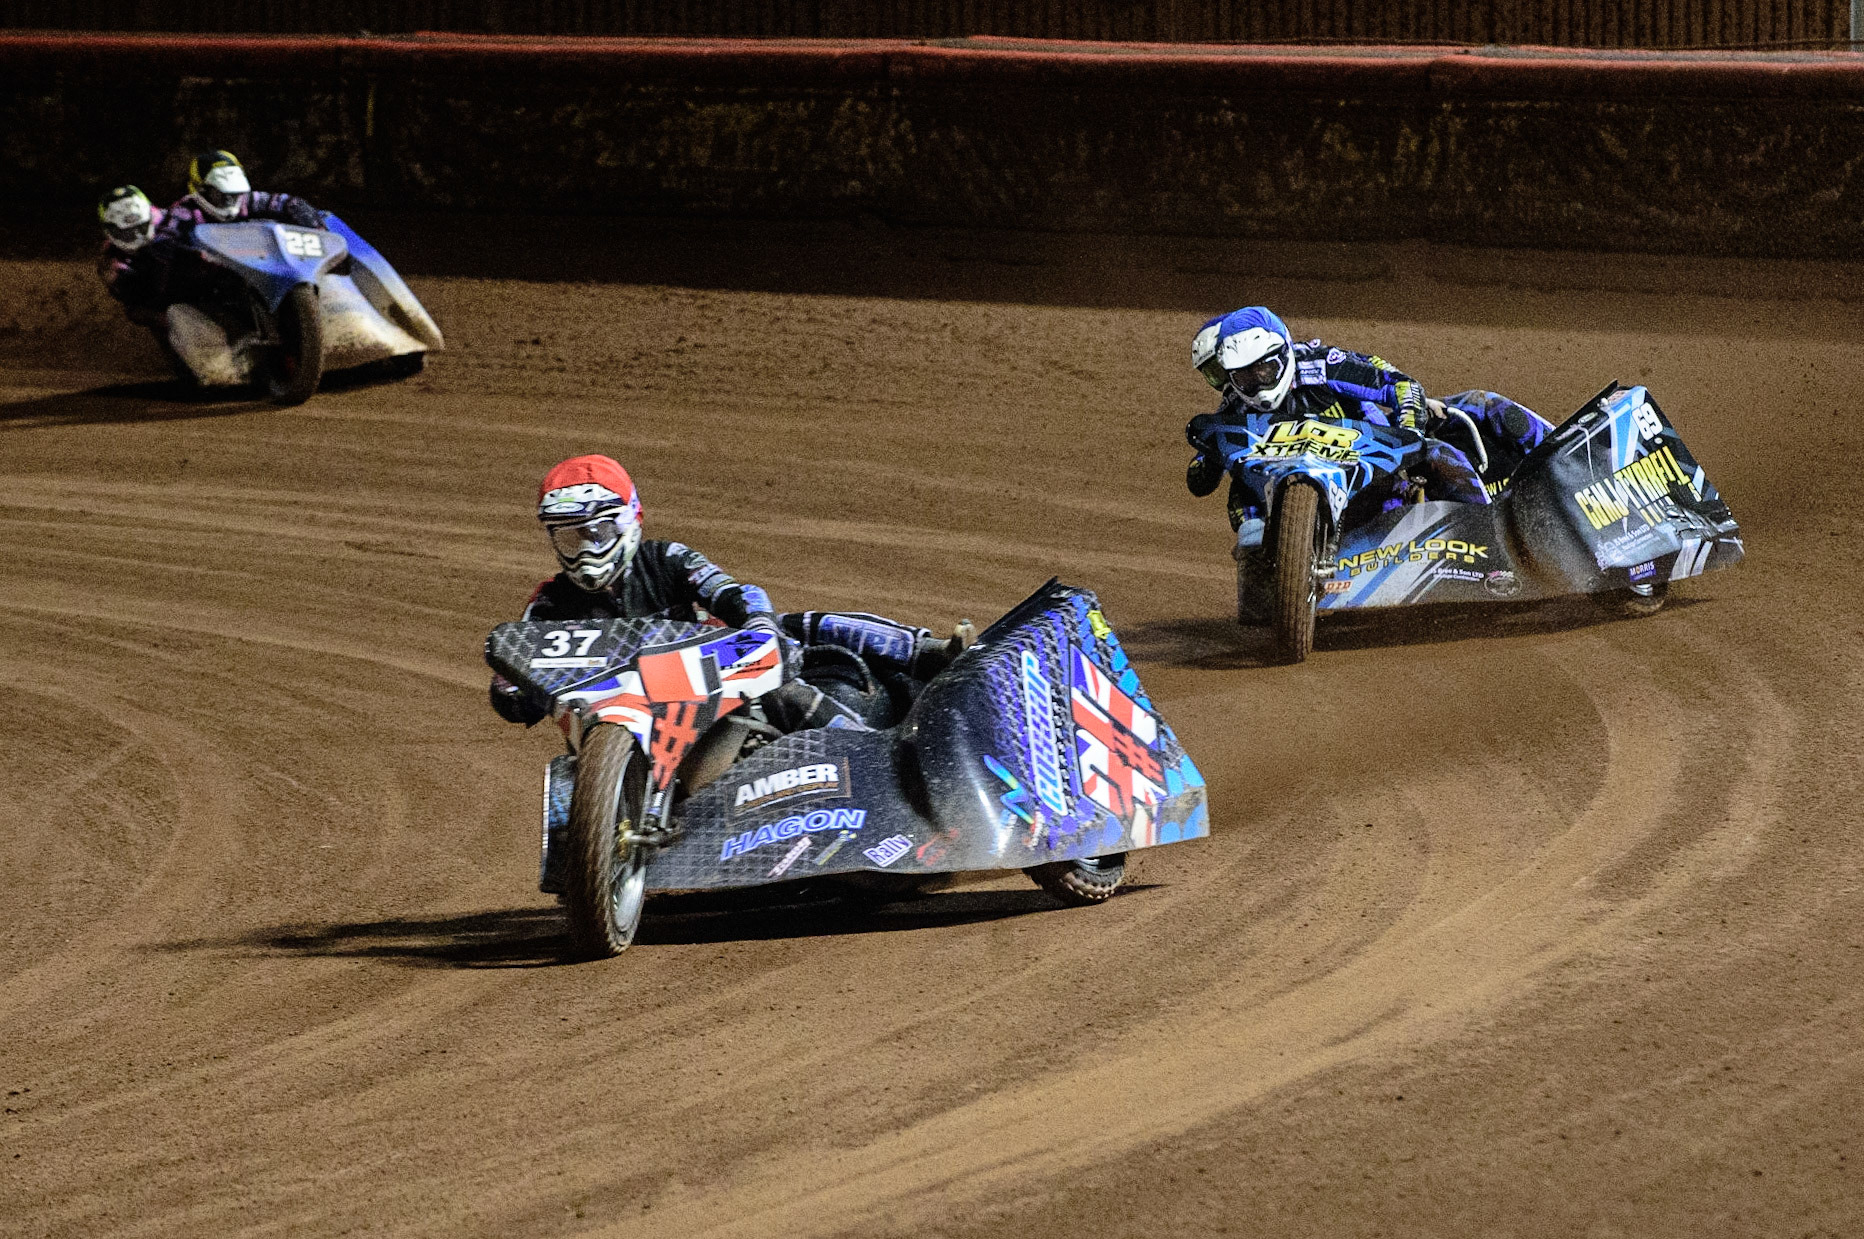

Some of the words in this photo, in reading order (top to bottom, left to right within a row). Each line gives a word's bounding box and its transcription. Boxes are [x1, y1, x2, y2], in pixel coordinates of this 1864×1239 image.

[284, 230, 324, 257] 22
[1631, 402, 1663, 441] 69
[1253, 439, 1361, 462] XTREME
[1338, 542, 1404, 572] NEW
[1408, 539, 1489, 559] LOOK
[1350, 553, 1476, 577] BUILDERS
[1629, 561, 1655, 576] MORRIS
[1472, 571, 1485, 579] LTD
[541, 629, 603, 657] 37
[734, 763, 839, 807] AMBER
[719, 808, 868, 862] HAGON
[866, 835, 912, 864] Rally
